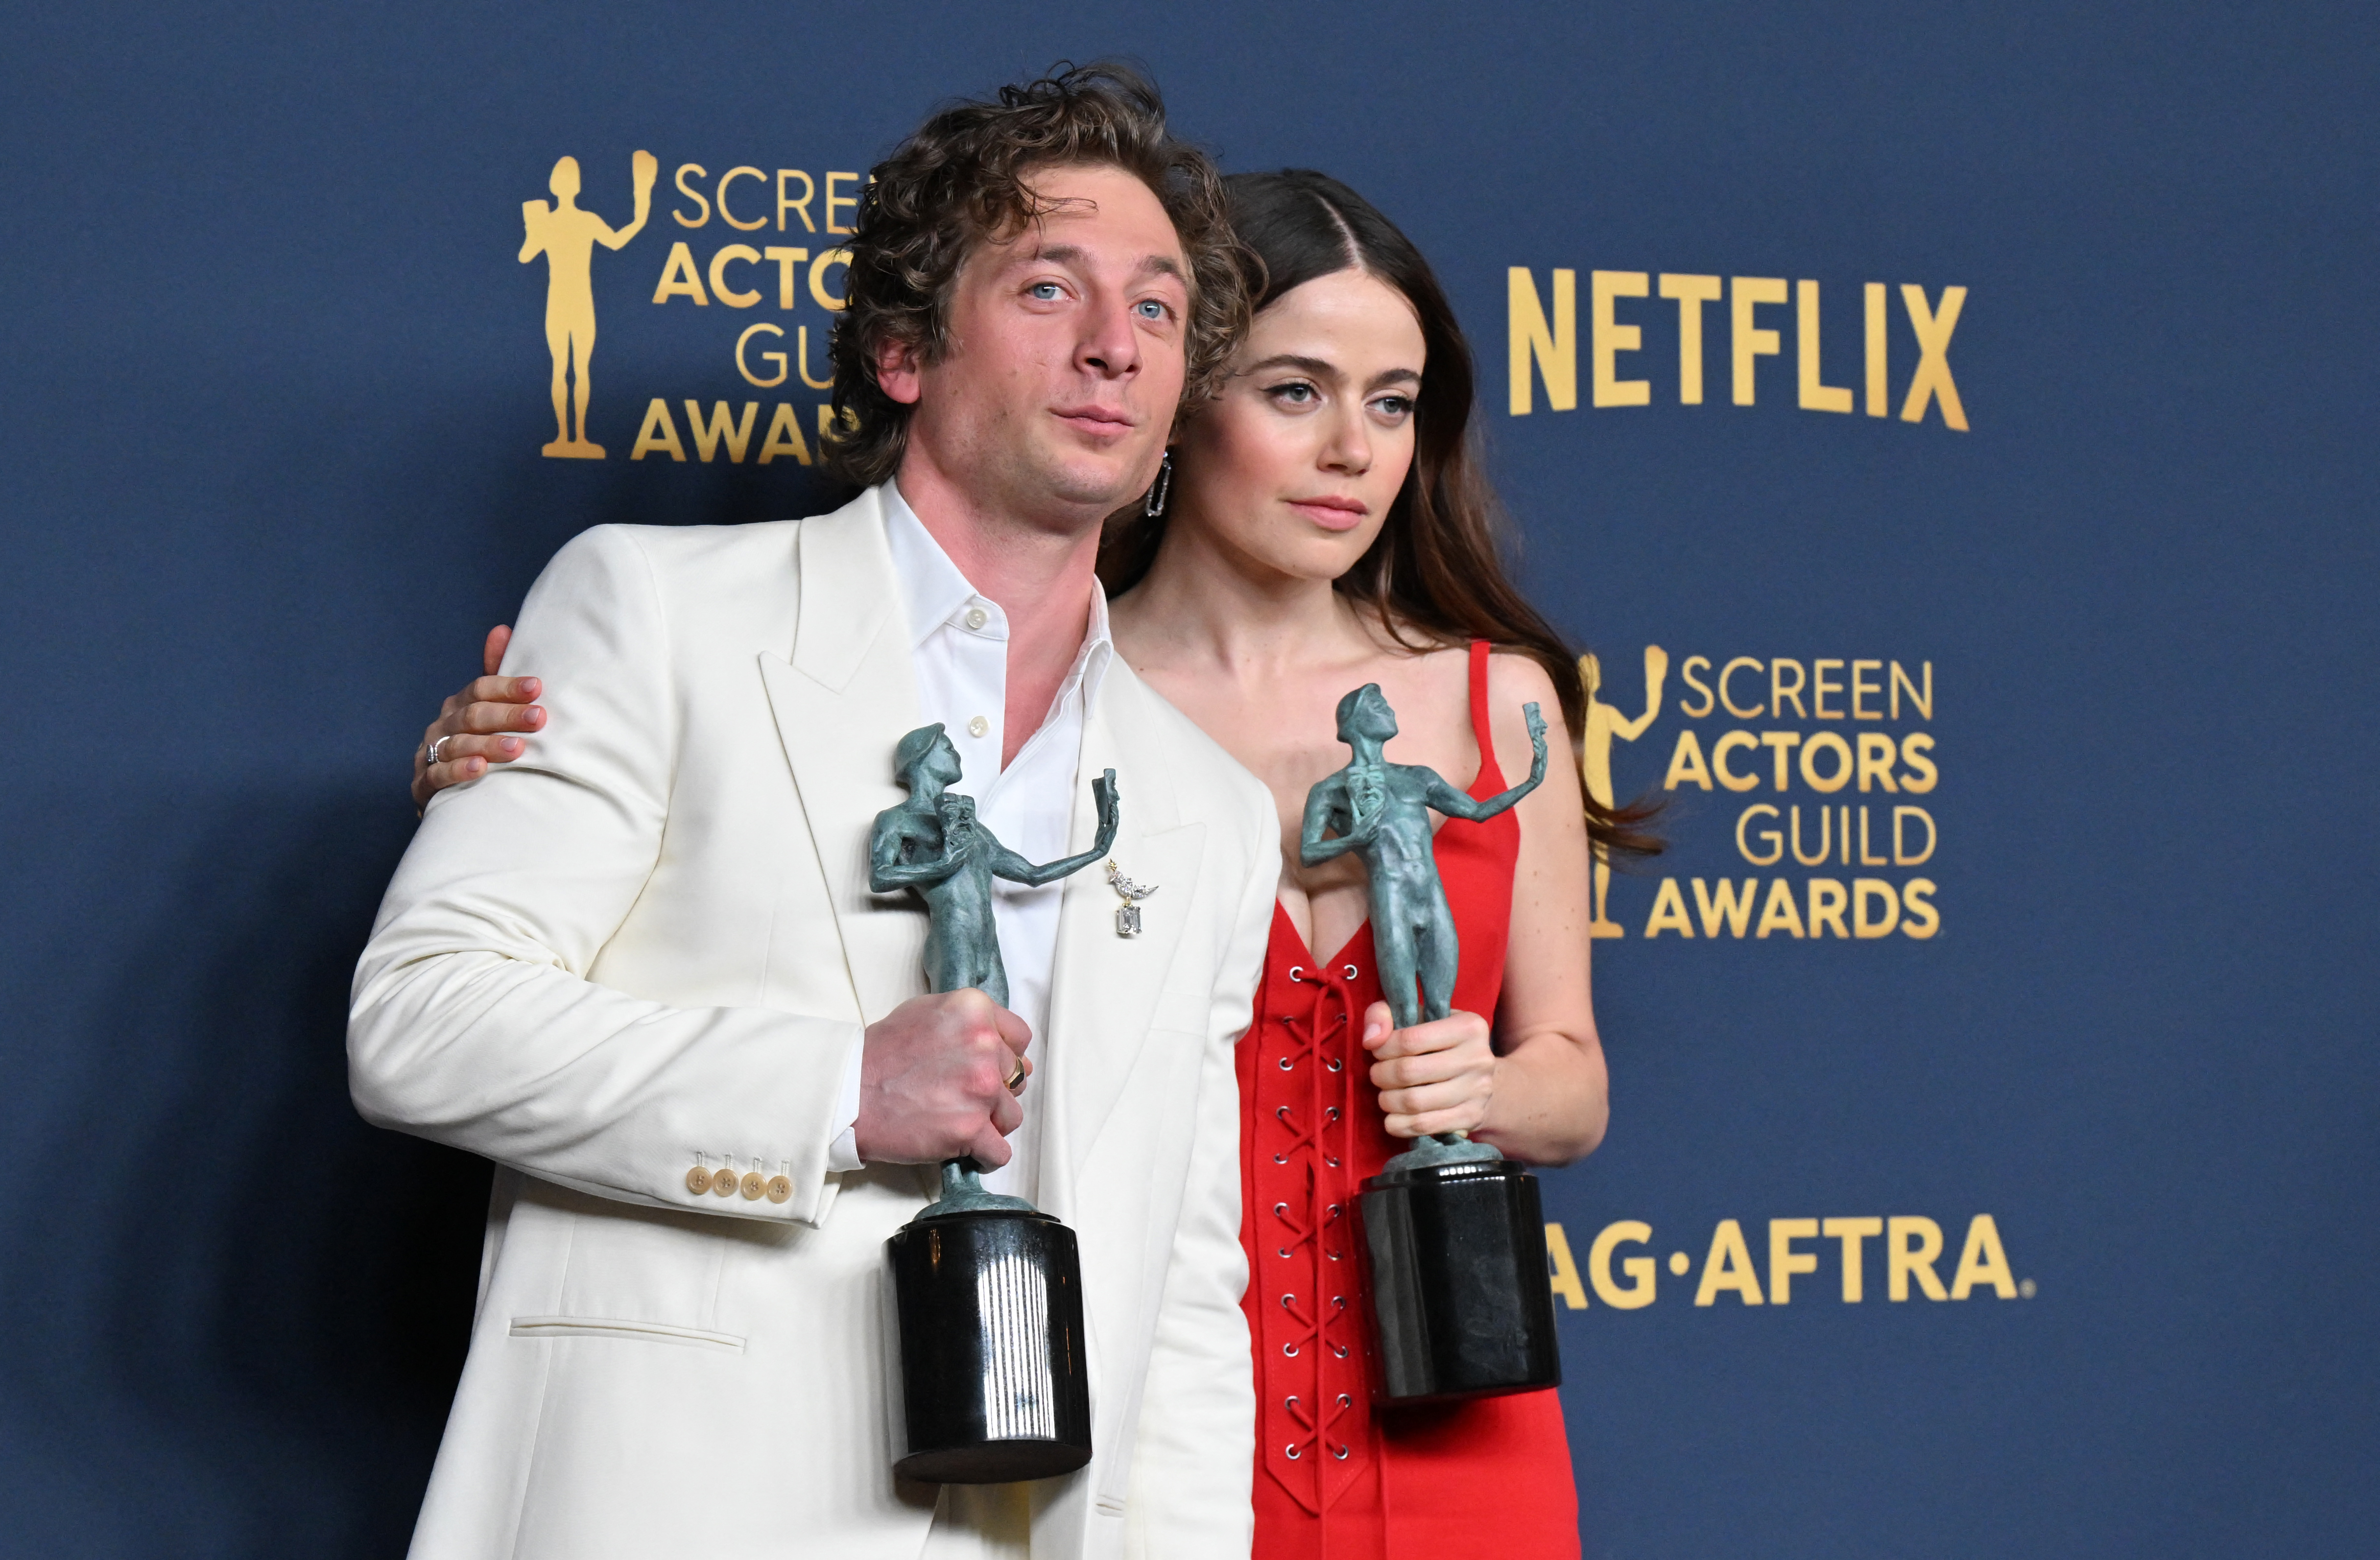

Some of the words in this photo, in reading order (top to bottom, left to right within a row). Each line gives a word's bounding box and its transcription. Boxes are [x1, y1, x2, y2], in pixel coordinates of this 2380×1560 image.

[672, 163, 879, 235] SCRE
[1508, 266, 1970, 431] NETFLIX
[1680, 656, 1933, 720] SCREEN
[1664, 730, 1938, 794] ACTORS
[1736, 804, 1937, 866] GUILD
[1644, 878, 1940, 939] AWARDS
